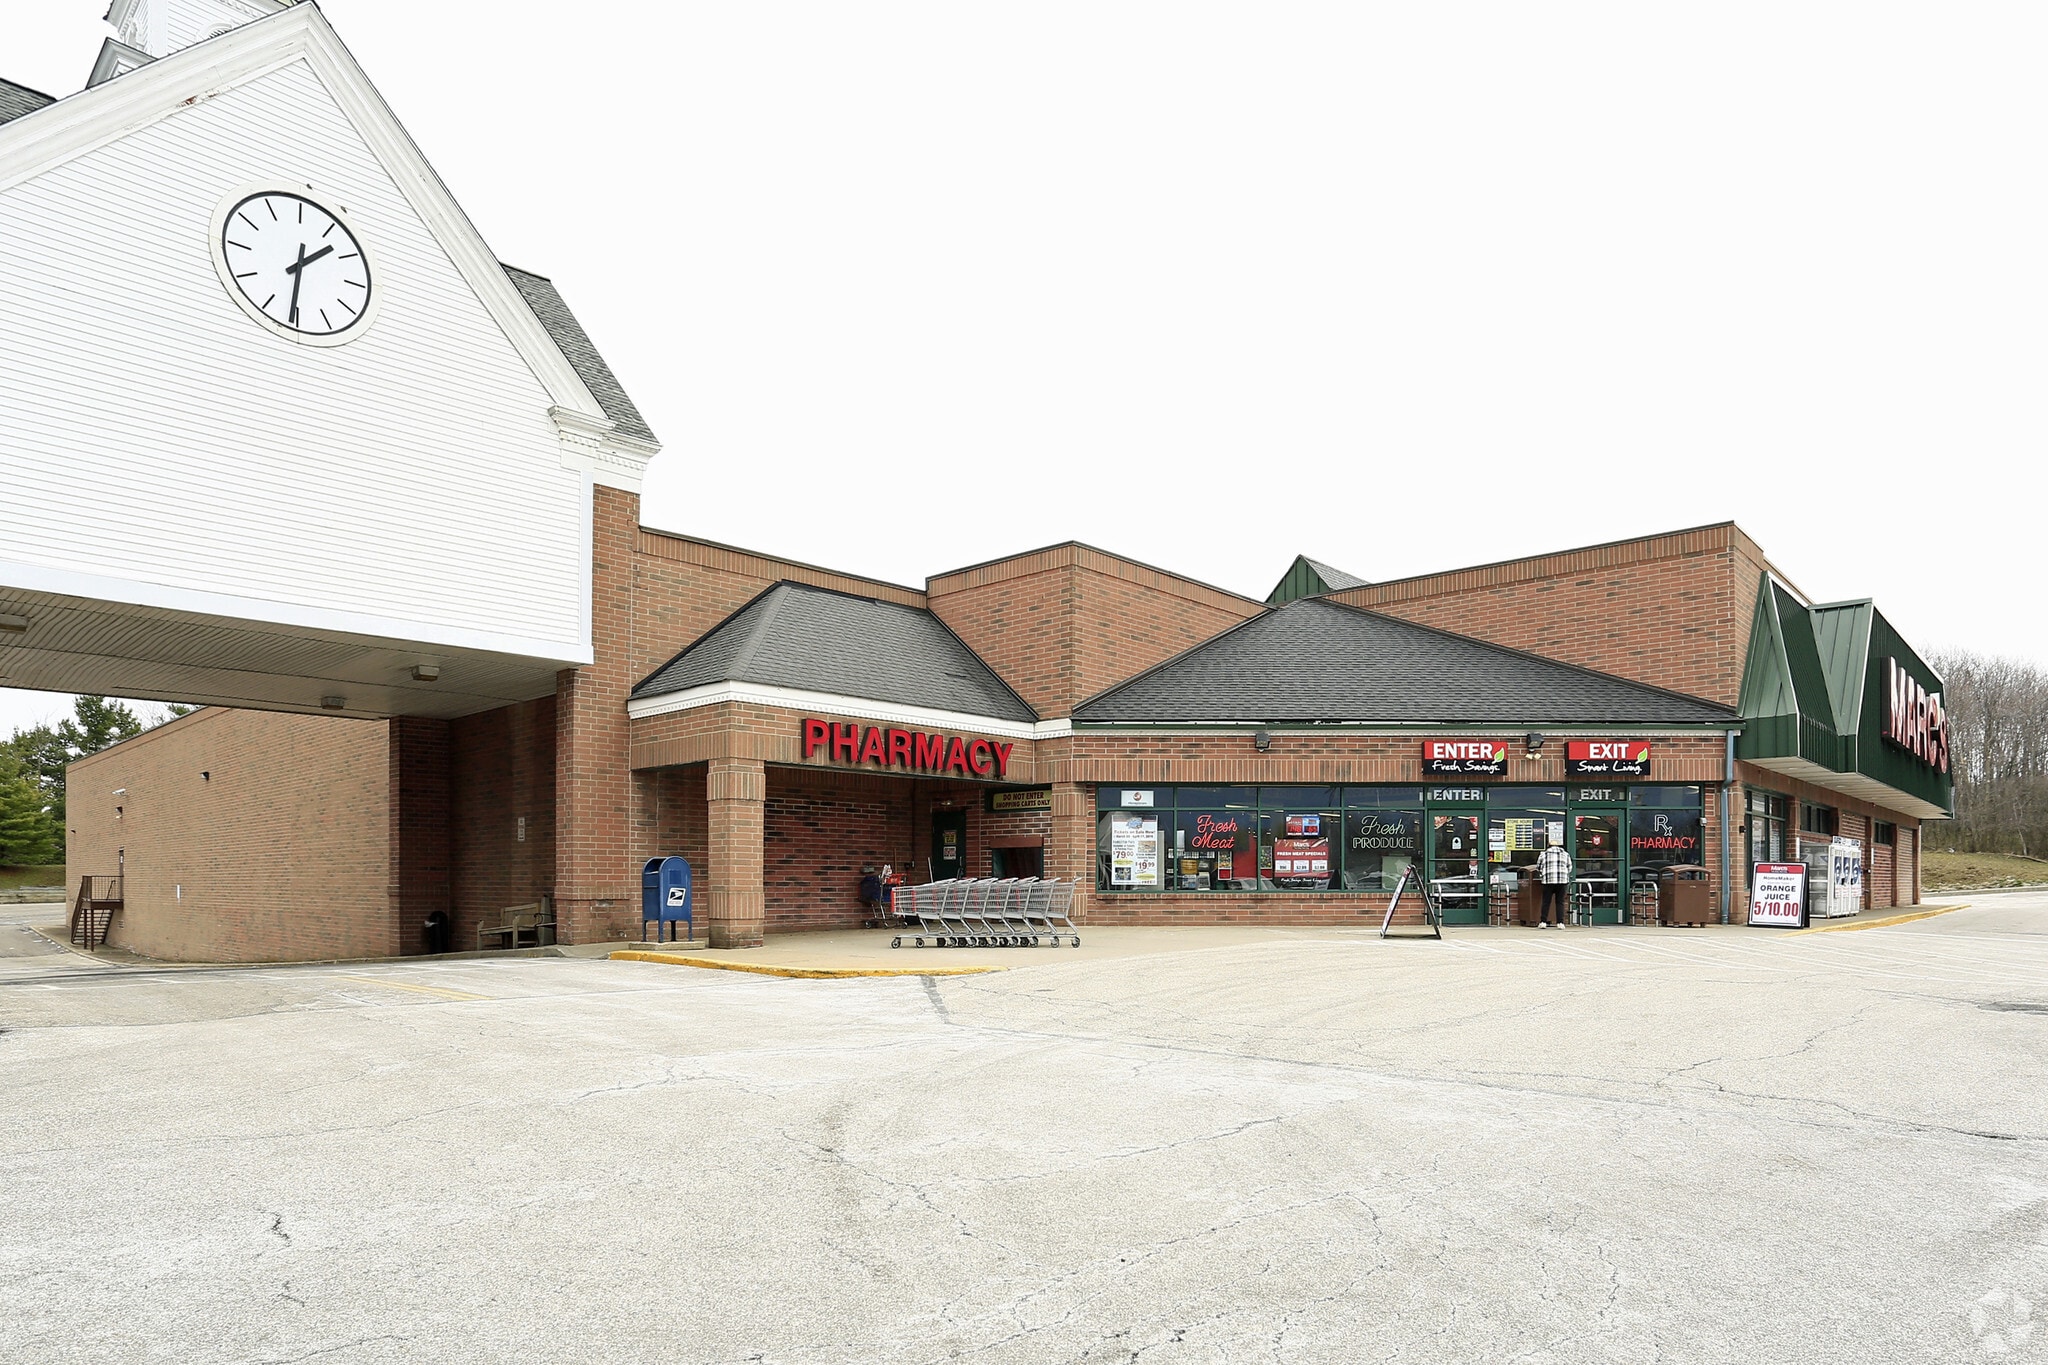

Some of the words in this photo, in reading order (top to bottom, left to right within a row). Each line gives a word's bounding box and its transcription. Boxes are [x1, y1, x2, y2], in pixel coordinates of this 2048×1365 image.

[803, 718, 1014, 776] PHARMACY
[1433, 742, 1493, 759] ENTER
[1589, 742, 1630, 759] EXIT
[1432, 760, 1462, 773] Fresh
[1577, 760, 1609, 773] Smart
[1026, 791, 1044, 800] ENTER
[1433, 789, 1481, 801] ENTER
[1580, 788, 1612, 800] EXIT
[1196, 814, 1238, 833] Fresh
[1361, 815, 1406, 835] Fresh
[1654, 814, 1673, 836] Rx
[1191, 832, 1235, 849] Meat
[1352, 837, 1414, 849] PRODUCE
[1631, 836, 1696, 849] PHARMACY
[1760, 884, 1797, 892] ORANGE
[1754, 901, 1799, 917] 5/10.00
